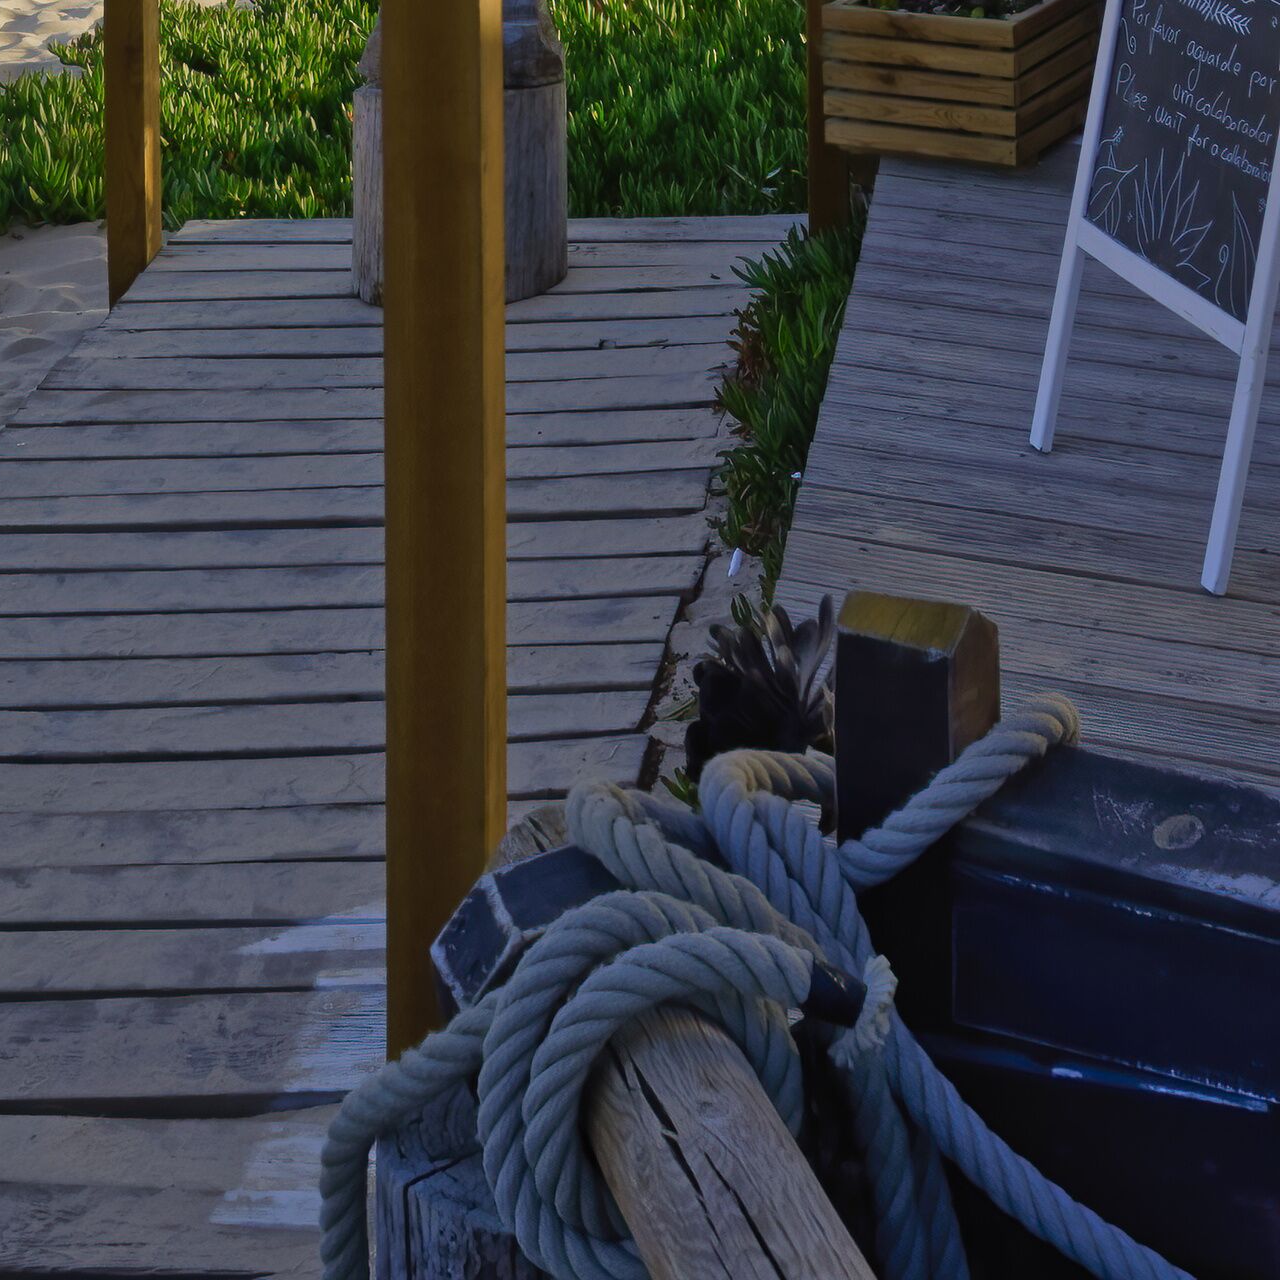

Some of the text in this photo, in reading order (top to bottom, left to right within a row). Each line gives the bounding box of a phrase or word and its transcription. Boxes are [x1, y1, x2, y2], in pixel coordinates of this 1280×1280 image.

[1186, 40, 1242, 92] aguarde
[1248, 71, 1277, 98] por
[1187, 123, 1210, 157] for
